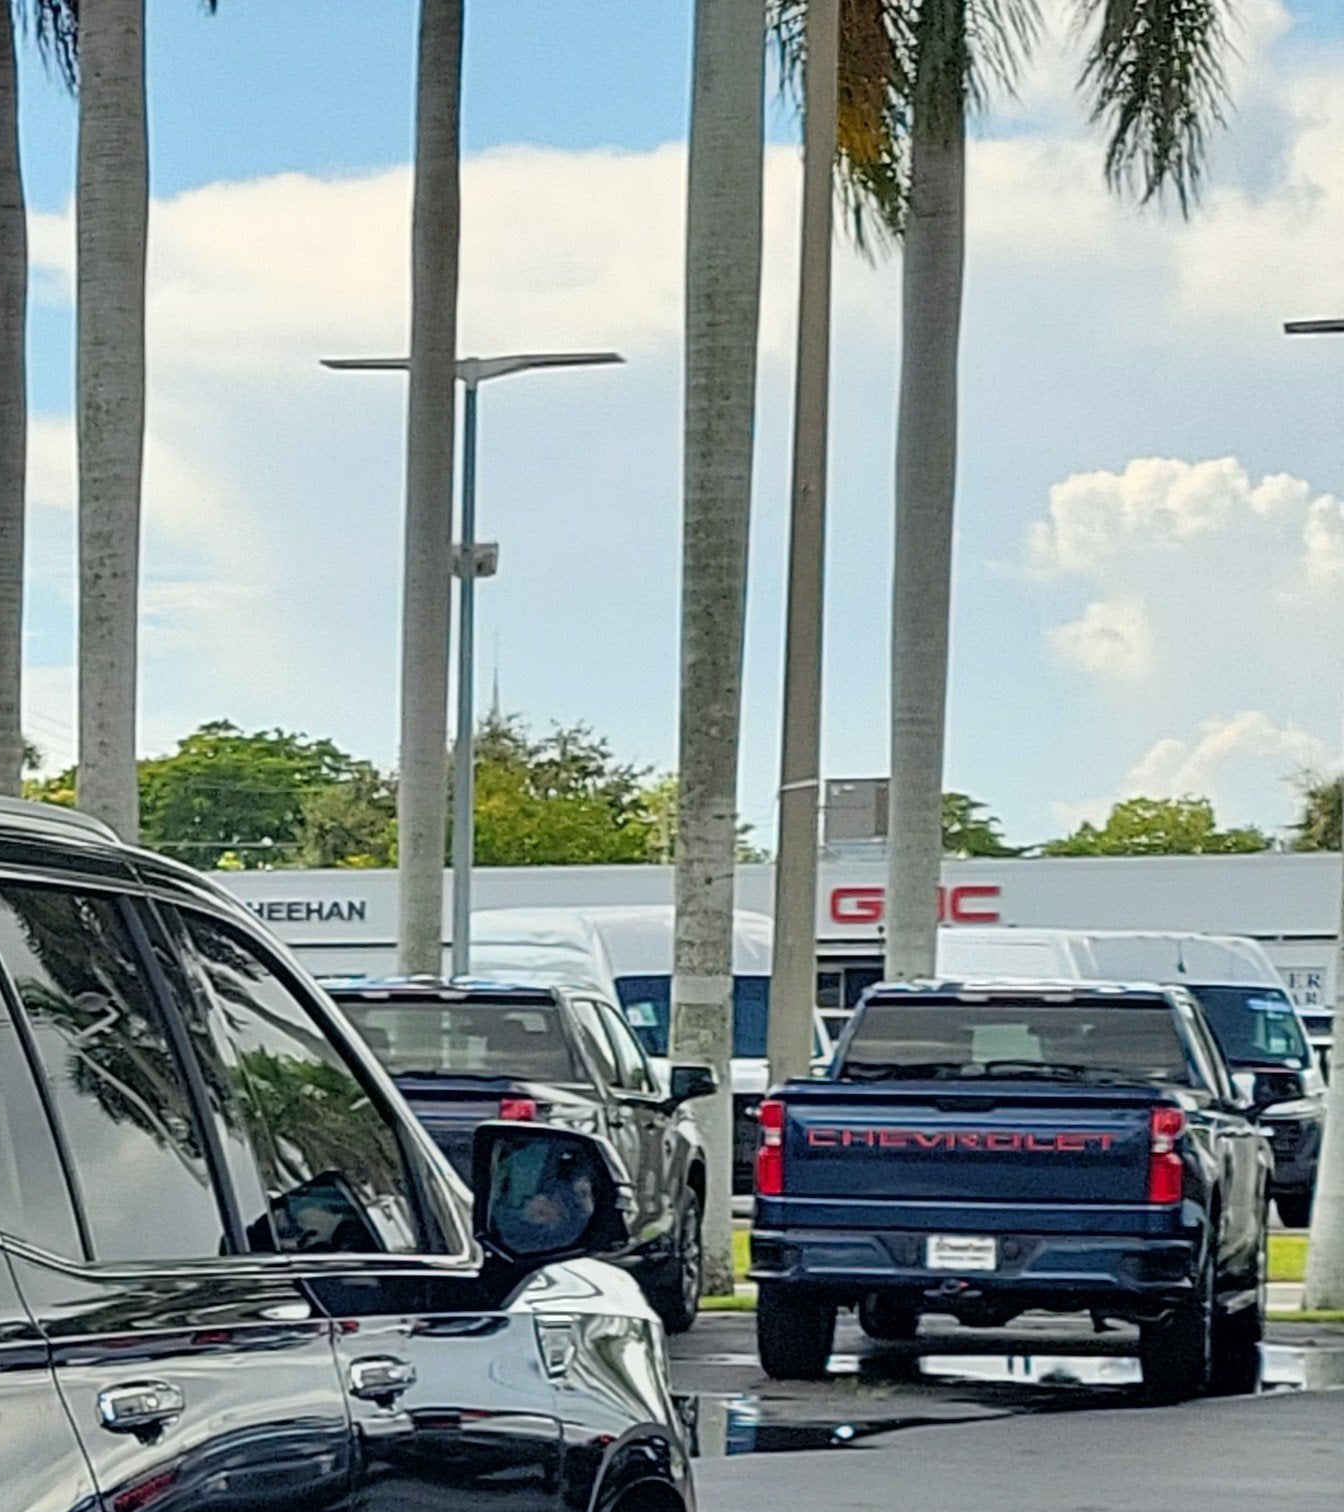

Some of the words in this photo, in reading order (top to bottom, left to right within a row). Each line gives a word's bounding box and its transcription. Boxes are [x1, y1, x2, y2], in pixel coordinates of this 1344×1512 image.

[245, 899, 367, 922] HEEHAN
[830, 885, 1002, 925] GC
[806, 1127, 1118, 1151] CHEVROLET
